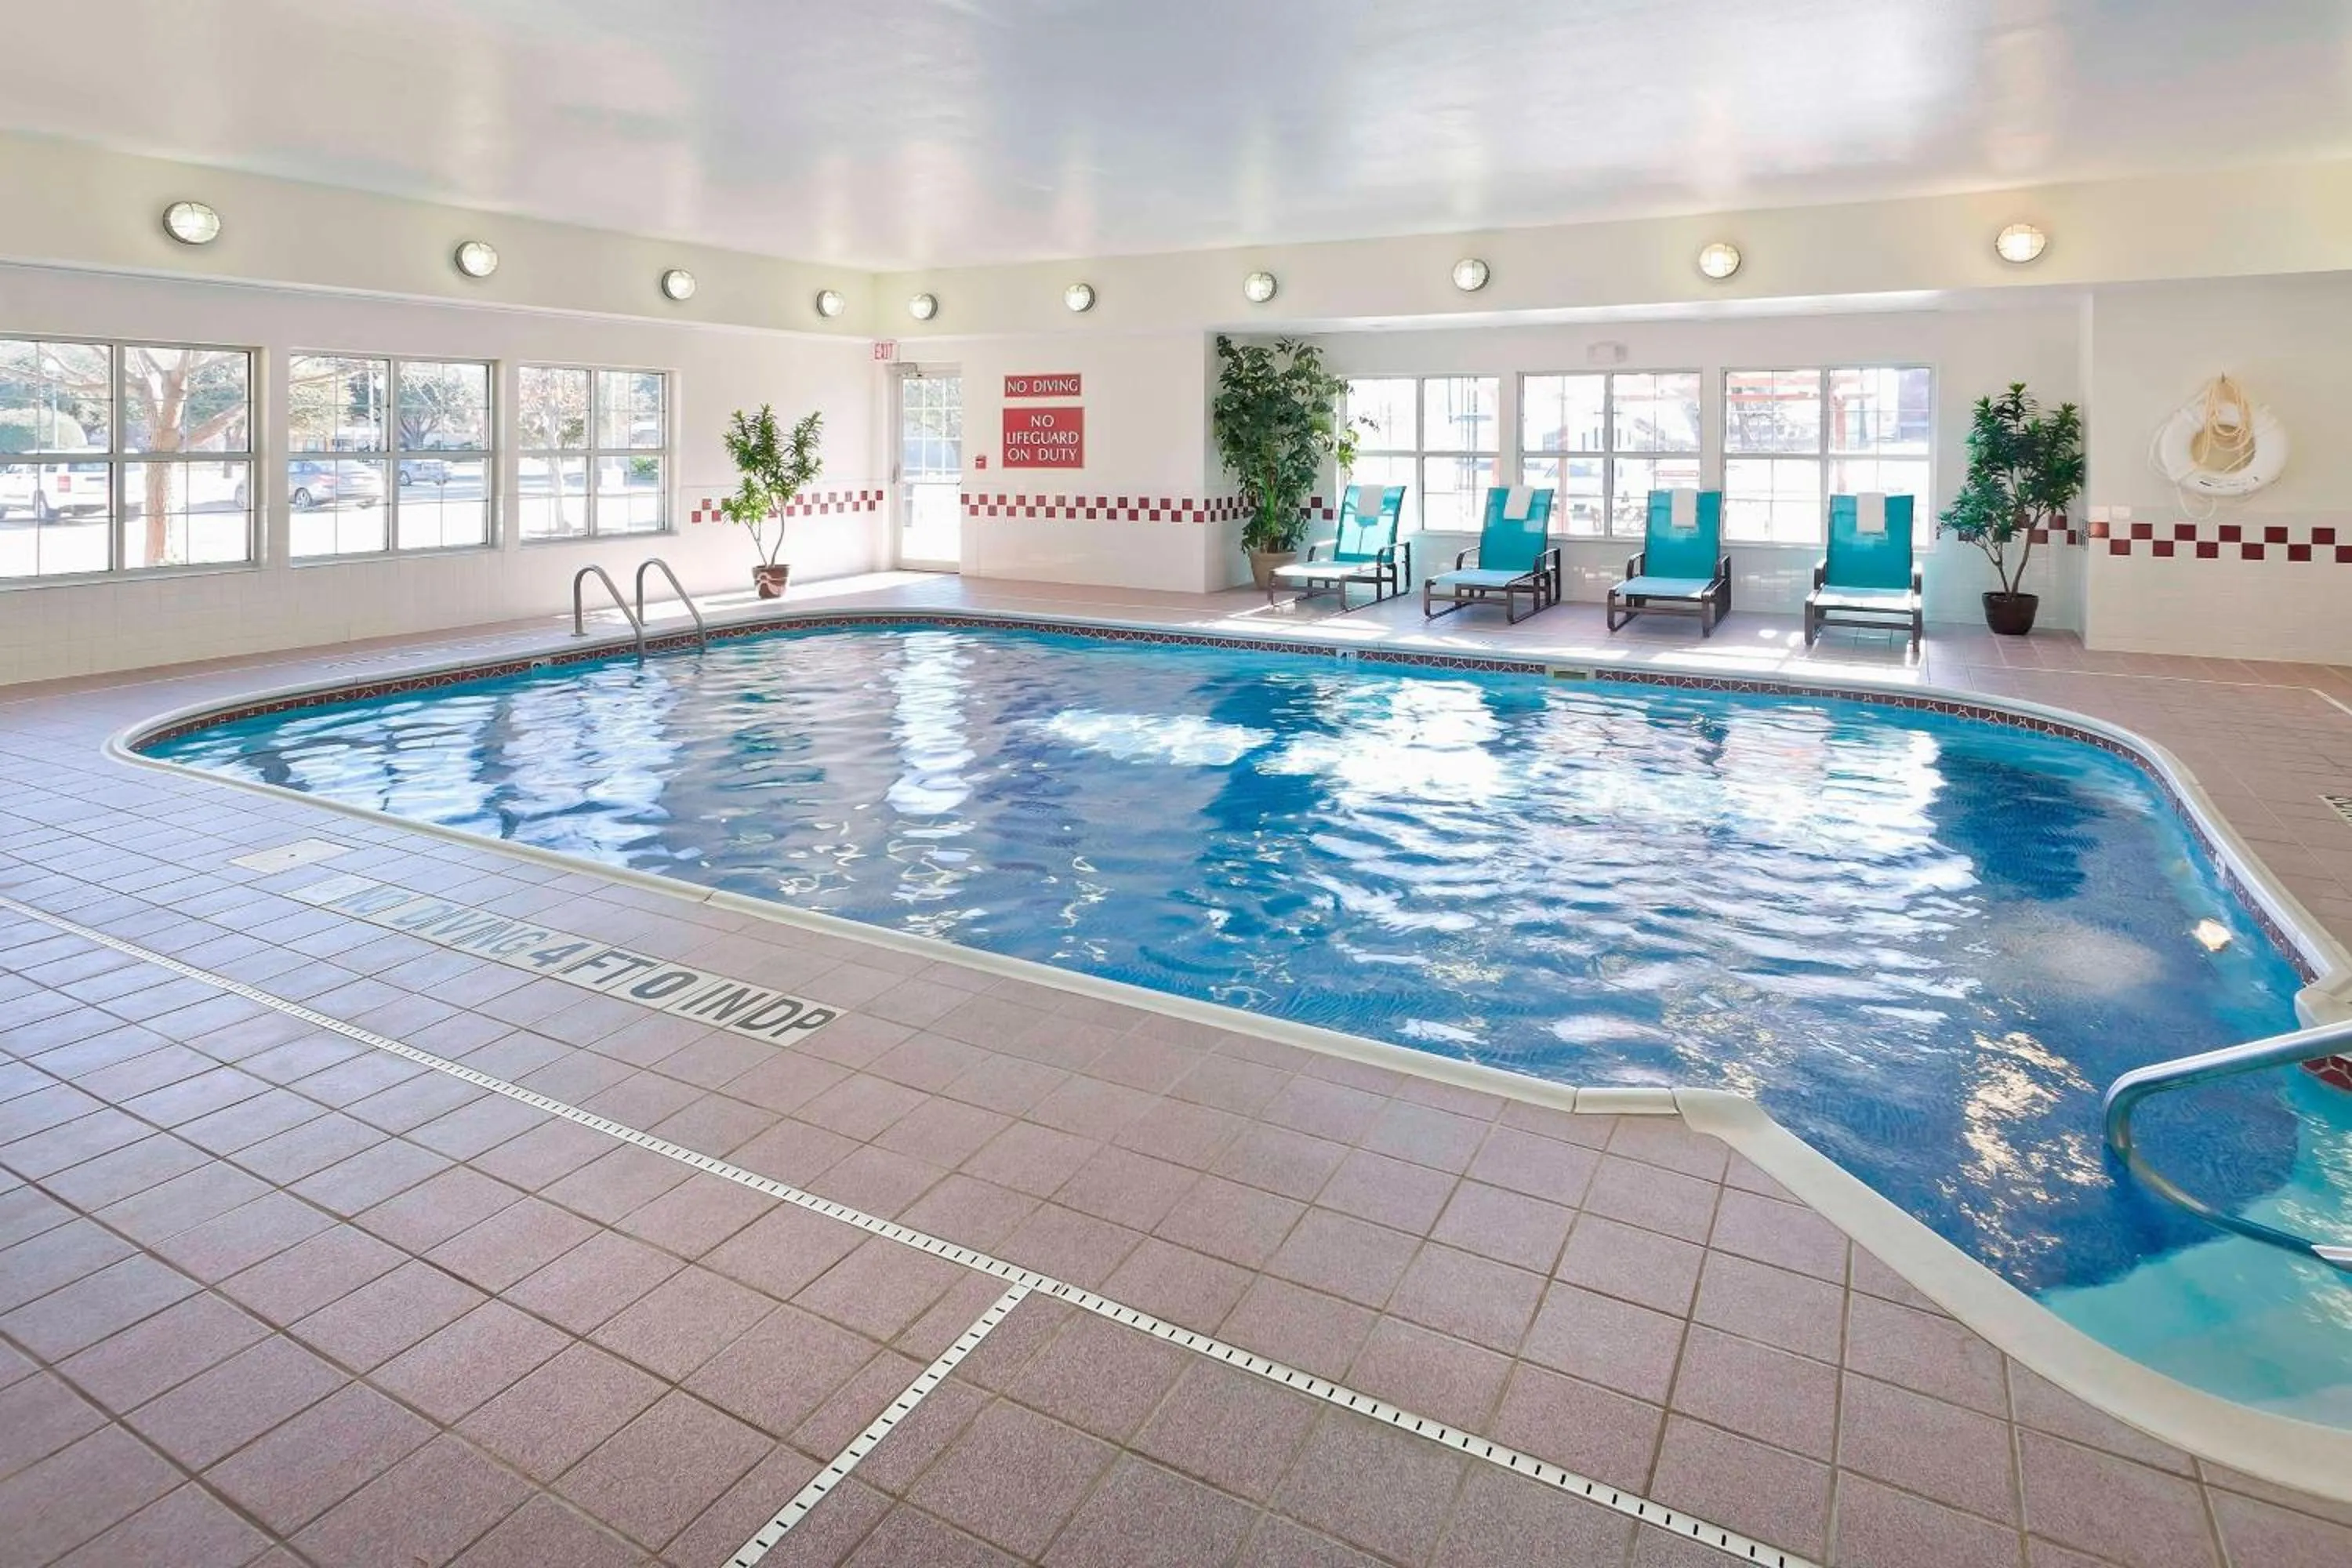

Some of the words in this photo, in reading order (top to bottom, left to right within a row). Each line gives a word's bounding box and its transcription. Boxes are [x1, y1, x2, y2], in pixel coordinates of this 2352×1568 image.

[874, 343, 893, 360] EXIT
[1007, 380, 1028, 393] NO
[1033, 379, 1078, 392] DIVING
[1031, 415, 1054, 427] NO
[1006, 431, 1079, 445] LIFEGUARD
[1007, 448, 1029, 461] ON
[1038, 448, 1077, 461] DUTY
[390, 904, 549, 954] DIVING
[528, 942, 591, 968] 4
